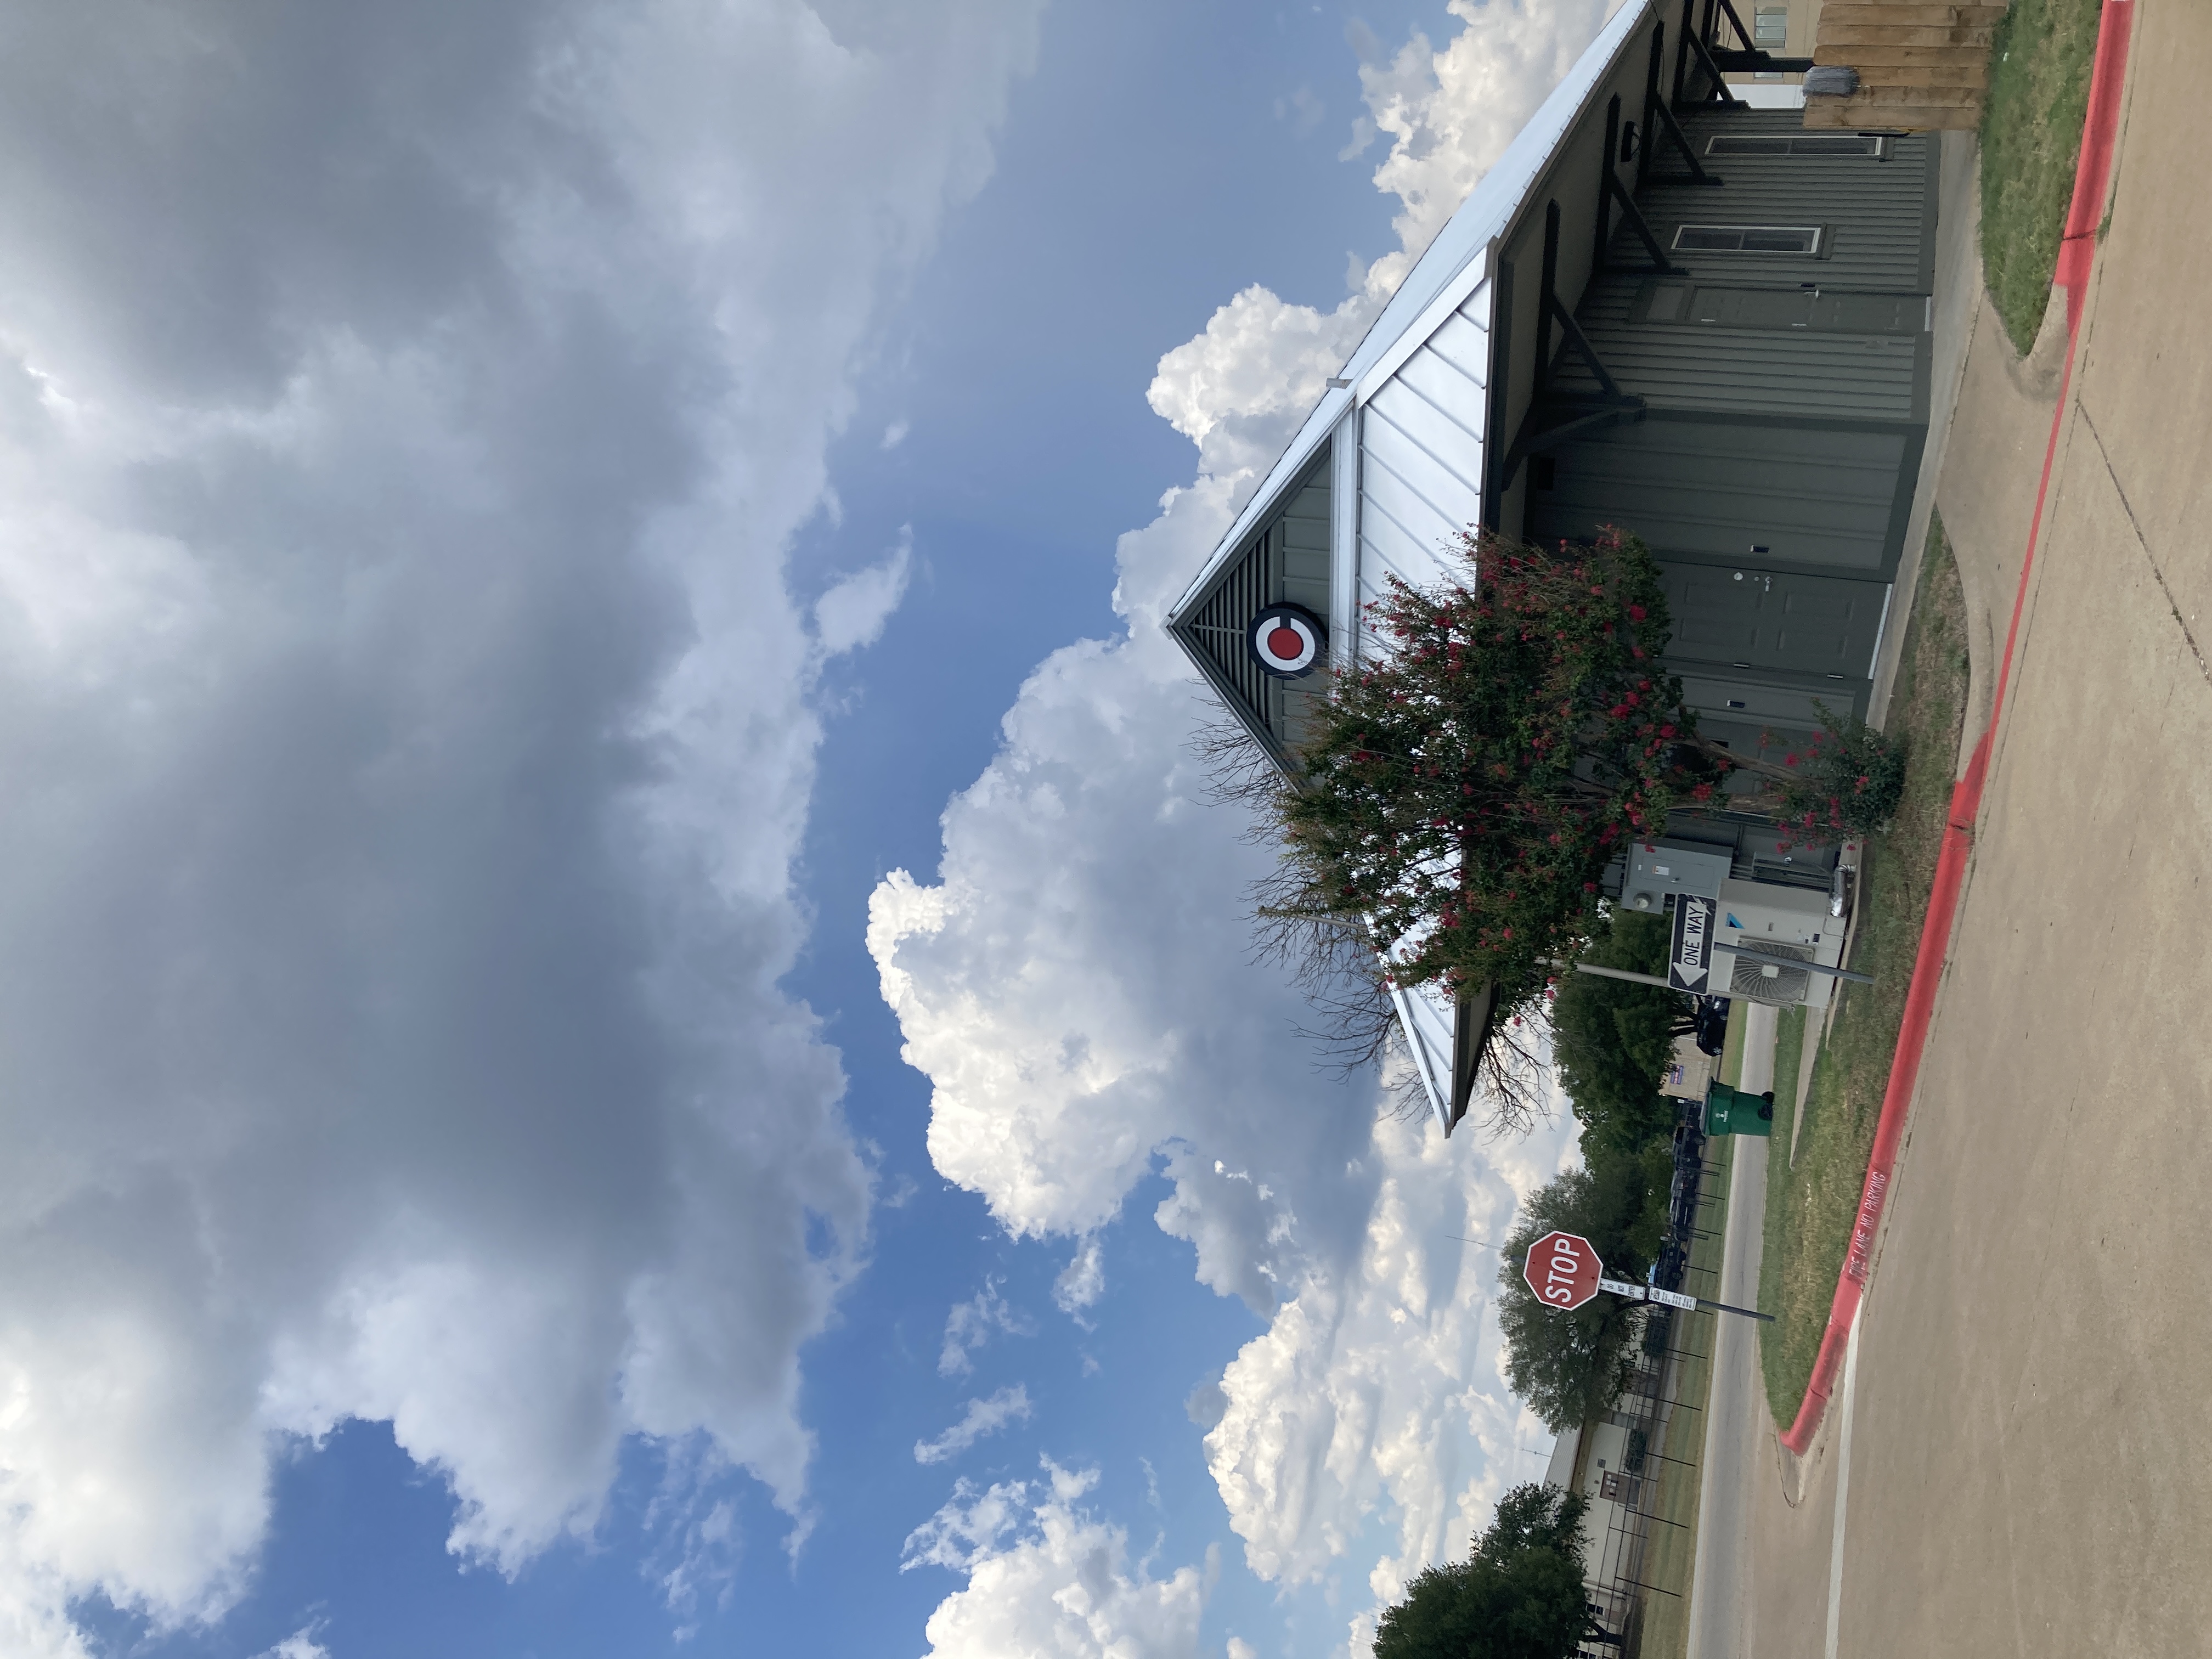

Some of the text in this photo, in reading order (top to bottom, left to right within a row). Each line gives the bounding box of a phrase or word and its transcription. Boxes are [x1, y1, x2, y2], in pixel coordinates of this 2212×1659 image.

[1683, 906, 1703, 966] ONE WAY
[1849, 1171, 1886, 1280] FIRE LANE NO PARKING
[1544, 1238, 1581, 1303] STOP
